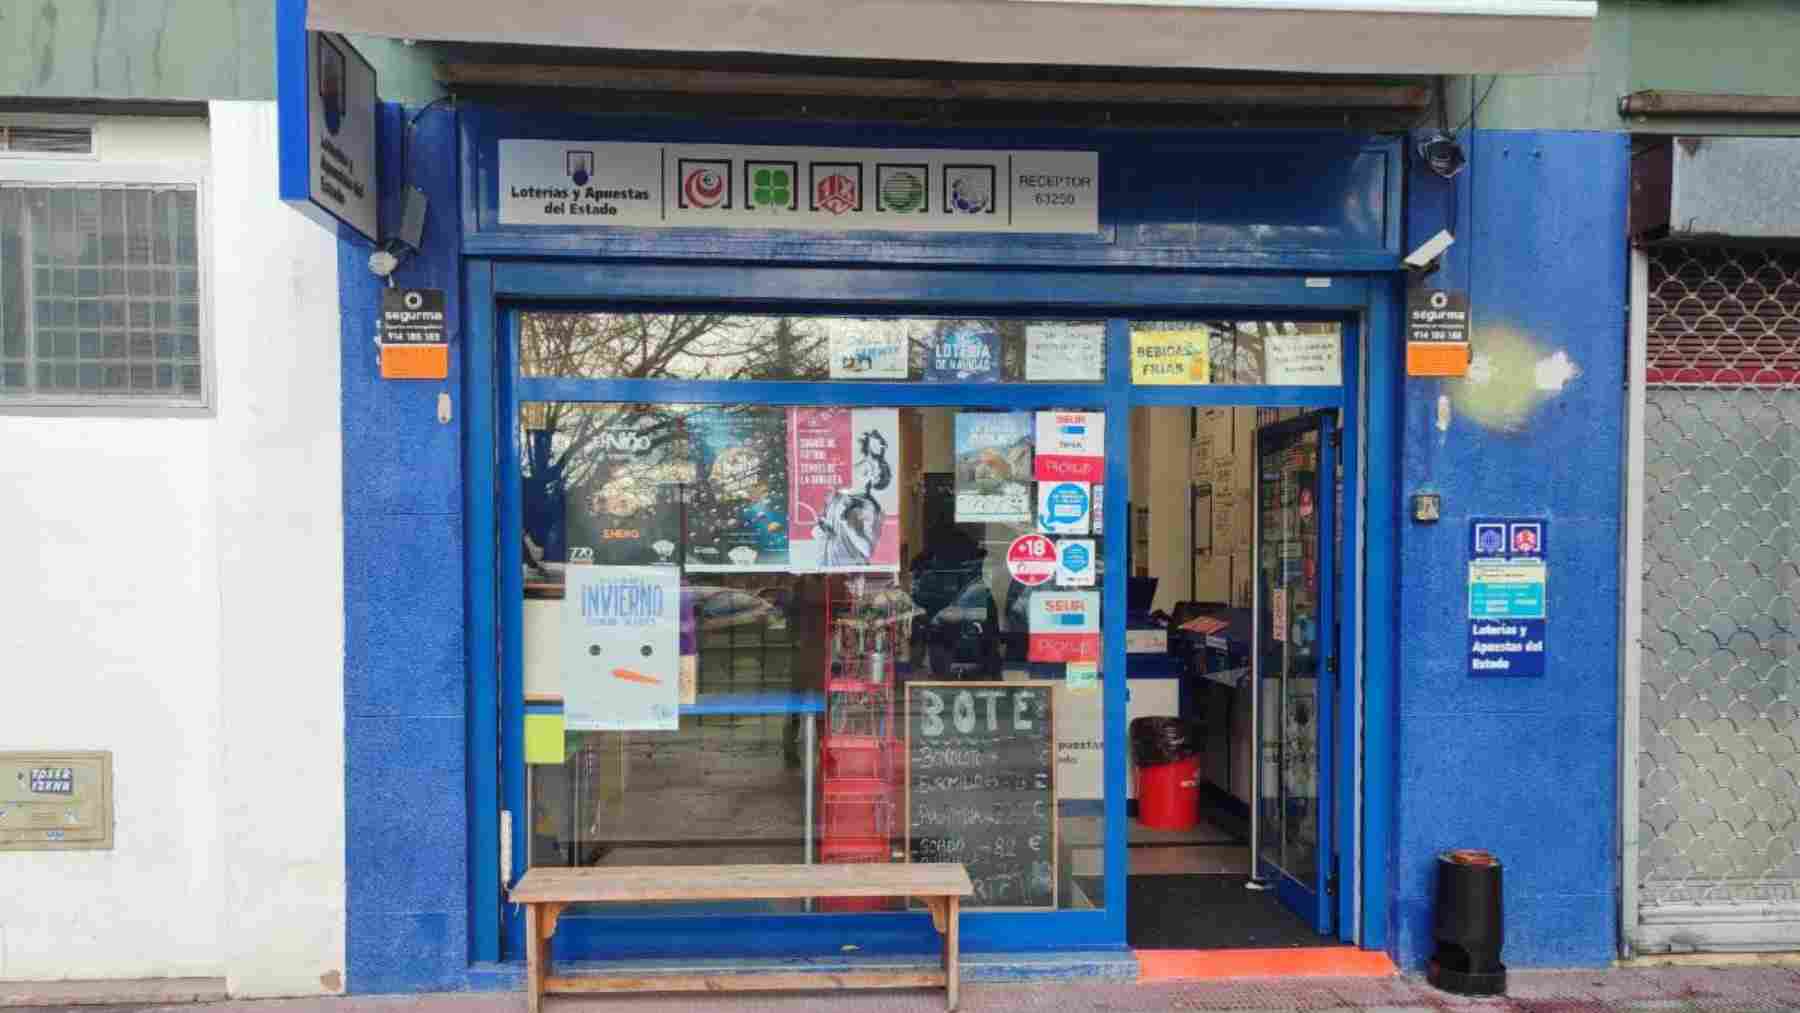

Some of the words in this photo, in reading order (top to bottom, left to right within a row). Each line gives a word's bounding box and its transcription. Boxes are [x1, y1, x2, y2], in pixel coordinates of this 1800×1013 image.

[1019, 175, 1091, 188] RECEPTOR
[573, 188, 581, 202] y
[585, 186, 649, 202] Apuestas
[544, 203, 566, 215] del
[569, 203, 617, 216] Estado
[385, 311, 443, 322] segurma
[1413, 310, 1465, 322] segurma
[1018, 539, 1046, 556] +18
[582, 583, 664, 617] INVIERNO
[1045, 599, 1087, 612] SEUR
[1520, 626, 1528, 638] y
[1472, 641, 1522, 655] Apuestas
[1525, 640, 1543, 652] del
[1472, 656, 1510, 670] Estado
[920, 689, 1036, 737] BOTE
